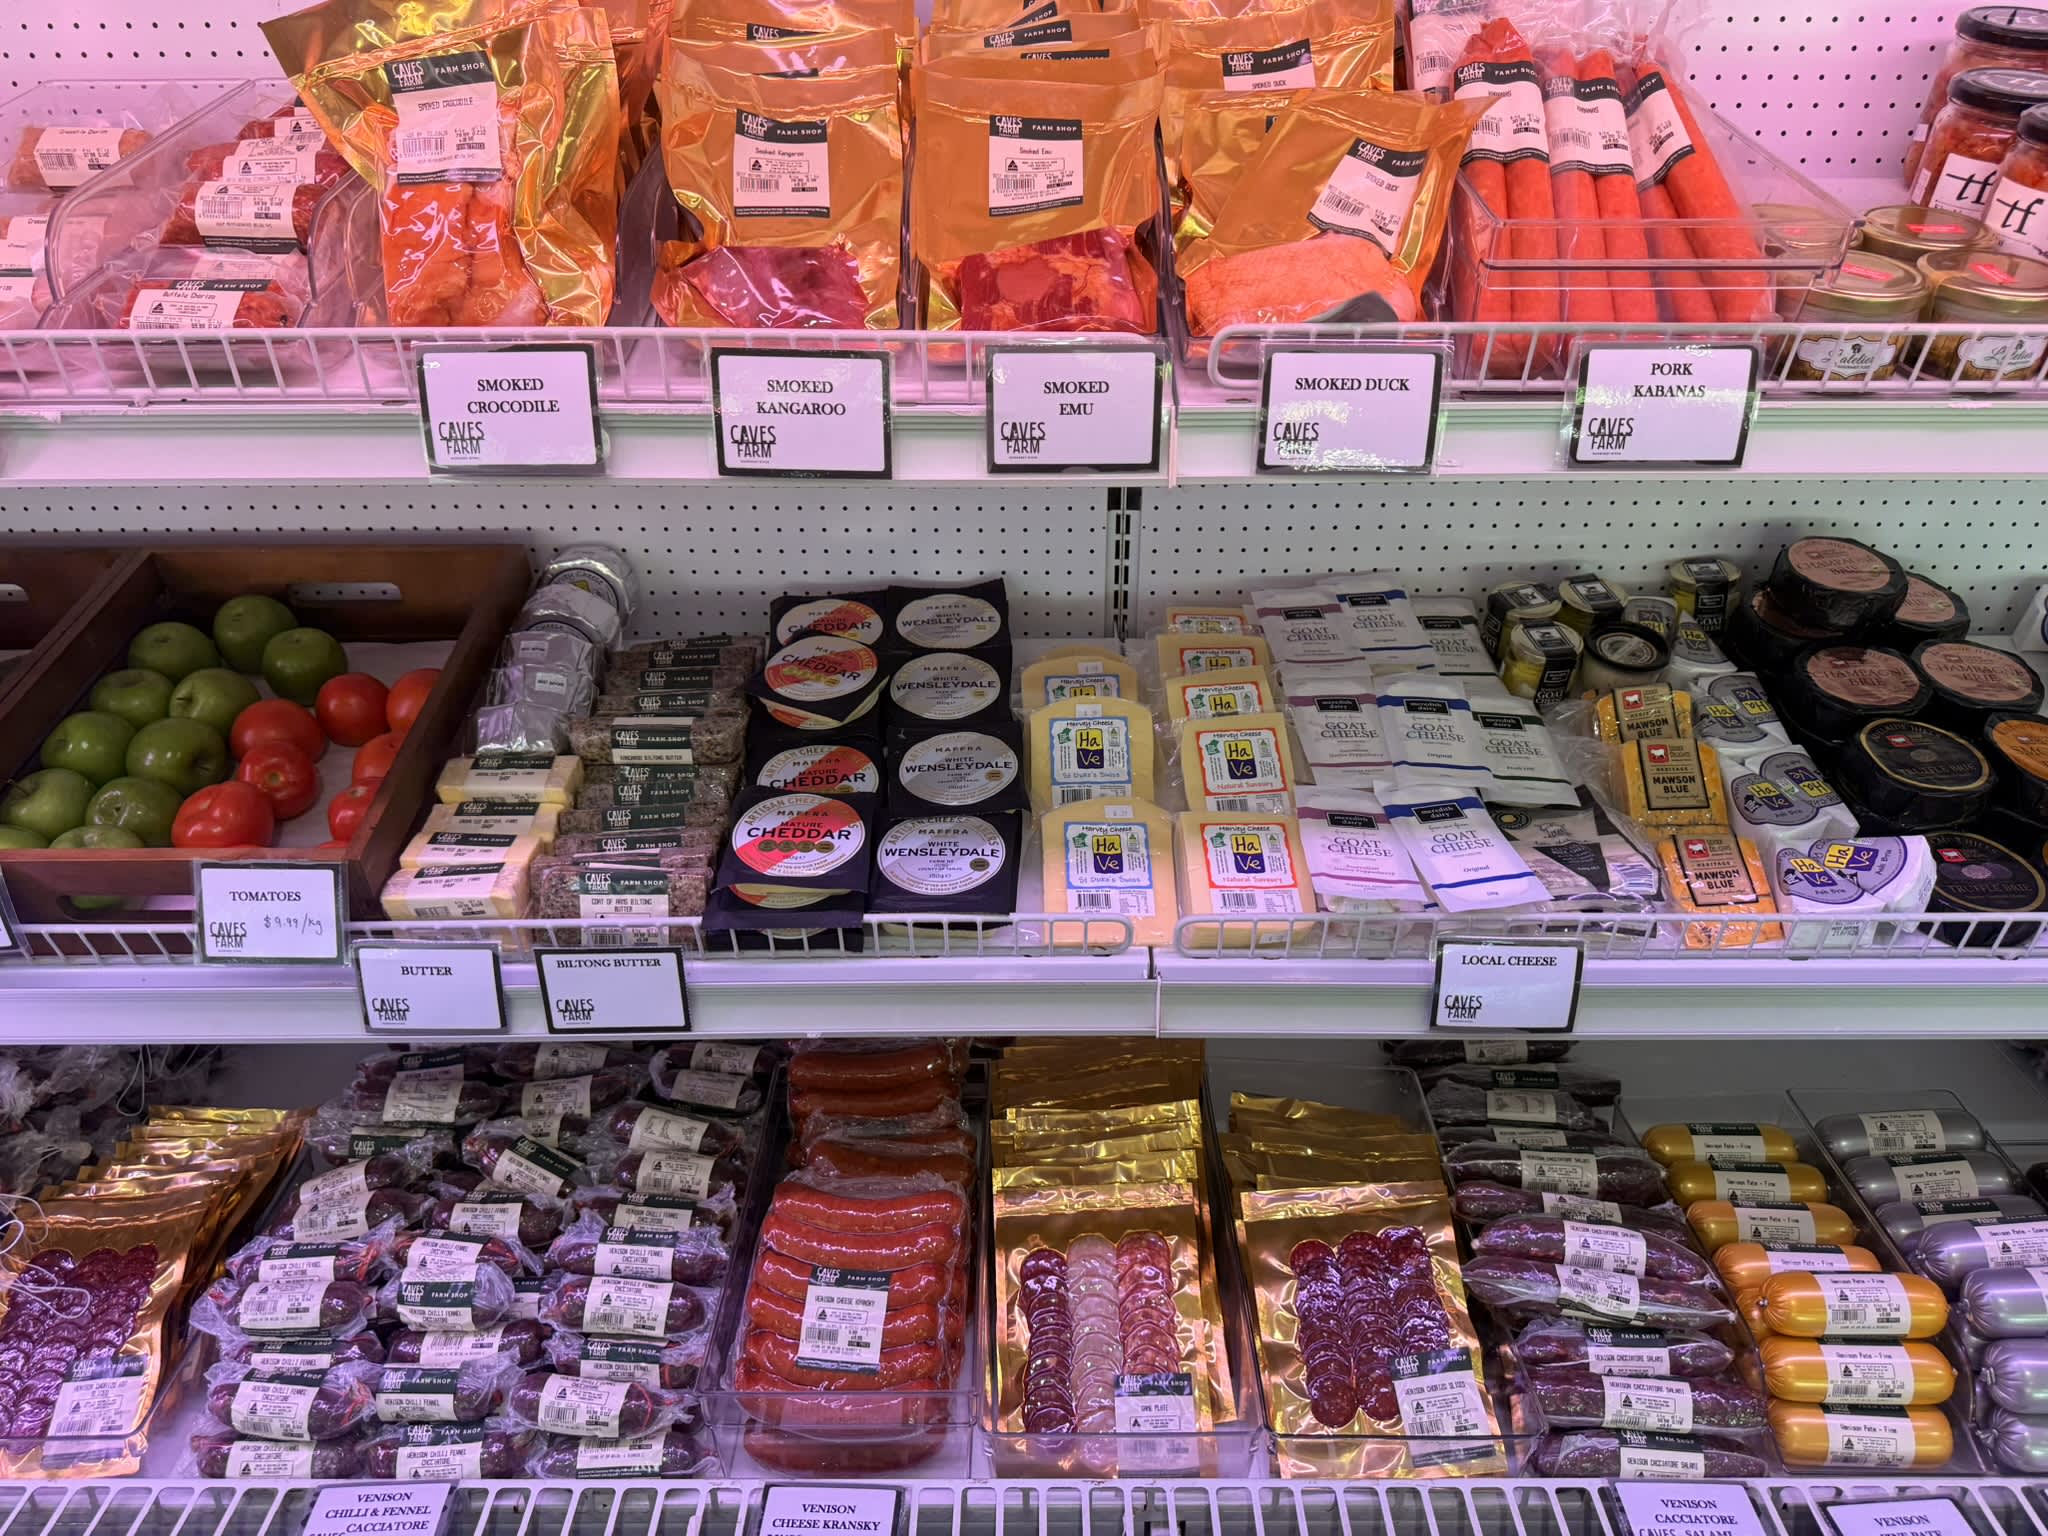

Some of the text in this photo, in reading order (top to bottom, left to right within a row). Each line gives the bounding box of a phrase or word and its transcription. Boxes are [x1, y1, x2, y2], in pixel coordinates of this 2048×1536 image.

[1047, 26, 1068, 35] SHOP
[1228, 52, 1254, 65] CAVES
[1286, 48, 1306, 60] SHOP
[392, 61, 424, 78] CAVES
[462, 62, 486, 72] SHOP
[1457, 62, 1486, 78] CAVES
[1580, 84, 1604, 94] FARM
[741, 114, 768, 129] CAVES
[995, 116, 1022, 127] CAVES
[777, 128, 822, 136] FARM SHOP
[999, 124, 1020, 135] FARM
[1358, 142, 1386, 159] CAVES
[1996, 198, 2044, 236] tf
[162, 290, 216, 300] Buffalo Chorizo
[1650, 362, 1693, 376] PORK
[477, 378, 544, 392] SMOKED
[767, 380, 834, 394] SMOKED
[1044, 381, 1110, 394] SMOKED
[1296, 378, 1410, 392] SMOKED DUCK
[1633, 384, 1706, 398] KABANAS
[467, 400, 560, 414] CROCODILE
[756, 402, 846, 416] KANGAROO
[1059, 403, 1094, 416] EMU
[438, 421, 485, 440] CAVES
[1000, 422, 1046, 440] CAVES
[1273, 422, 1319, 441] CAVES
[1588, 417, 1634, 436] CAVES
[730, 424, 776, 444] CAVES
[446, 440, 480, 455] FARM
[1006, 439, 1040, 454] FARM
[1591, 436, 1626, 450] FARM
[737, 443, 772, 458] FARM
[788, 622, 872, 634] CHEDDAR
[902, 616, 996, 628] WENSLEYDALE
[1352, 620, 1407, 629] CHEESE
[1286, 634, 1340, 642] CHEESE
[782, 654, 861, 680] CHEDDAR
[896, 680, 996, 692] WENSLEYDALE
[1213, 697, 1232, 712] Ha
[1710, 706, 1729, 716] Ha
[1325, 722, 1368, 730] GOAT
[1412, 723, 1454, 733] GOAT
[1626, 718, 1669, 732] MAWSON
[616, 730, 640, 740] CAVES
[1079, 732, 1100, 748] Ha
[1320, 730, 1379, 738] CHEESE
[1406, 732, 1466, 743] CHEESE
[1637, 728, 1662, 740] BLUE
[1489, 738, 1530, 748] GOAT
[1228, 743, 1250, 758] Ha
[1485, 746, 1543, 756] CHEESE
[1078, 750, 1101, 766] Ve
[904, 761, 1012, 773] WENSLEYDALE
[770, 772, 866, 788] CHEDDAR
[1652, 776, 1696, 785] MAWSON
[1664, 784, 1690, 794] BLUE
[747, 827, 852, 840] CHEDDAR
[1432, 830, 1478, 844] GOAT
[1096, 838, 1118, 852] Ha
[1236, 837, 1259, 852] Ha
[1334, 837, 1382, 849] GOAT
[1430, 838, 1494, 854] CHEESE
[884, 848, 1000, 858] WENSLEYDALE
[1328, 844, 1393, 858] CHEESE
[1096, 856, 1120, 871] Ve
[1237, 856, 1262, 870] Ve
[585, 873, 611, 885] CAVES
[1695, 869, 1740, 881] MAWSON
[1708, 880, 1735, 889] BLUE
[1950, 883, 2000, 894] TRUFFLE
[230, 890, 302, 902] TOMATOES
[210, 920, 246, 937] CAVES
[215, 936, 244, 949] FARM
[556, 957, 662, 969] BILTONG BUTTER
[1462, 955, 1558, 966] LOCAL CHEESE
[401, 966, 453, 977] BUTTER
[372, 997, 410, 1012] CAVES
[556, 997, 594, 1012] CAVES
[1444, 995, 1482, 1008] CAVES
[378, 1011, 407, 1022] FARM
[562, 1010, 592, 1022] FARM
[1448, 1008, 1477, 1019] FARM
[353, 1141, 375, 1151] CAVES
[1905, 1171, 1925, 1179] Venison
[1988, 1229, 2010, 1237] Venison
[268, 1262, 286, 1270] VENISON
[817, 1267, 840, 1277] CAVES
[402, 1284, 424, 1295] CAVES
[73, 1360, 96, 1370] CAVES
[1395, 1356, 1419, 1370] CAVES
[1120, 1375, 1142, 1385] CAVES
[271, 1386, 306, 1396] CHILLI FENNEL
[1427, 1384, 1448, 1393] CHORIZO
[408, 1424, 432, 1436] CAVES
[1840, 1424, 1897, 1434] Venison Fine
[240, 1444, 257, 1452] VENISON
[406, 1450, 428, 1459] VENISON
[1626, 1457, 1650, 1466] VENISON
[356, 1492, 412, 1504] VENISON
[1660, 1498, 1717, 1510] VENISON
[324, 1505, 432, 1518] CHILLI & FENNEL
[802, 1503, 856, 1514] VENISON
[1655, 1513, 1738, 1524] CACCIATORE
[1874, 1514, 1930, 1527] VENISON
[345, 1520, 429, 1534] CACCIATORE
[771, 1518, 882, 1532] CHEESE KRANSKY
